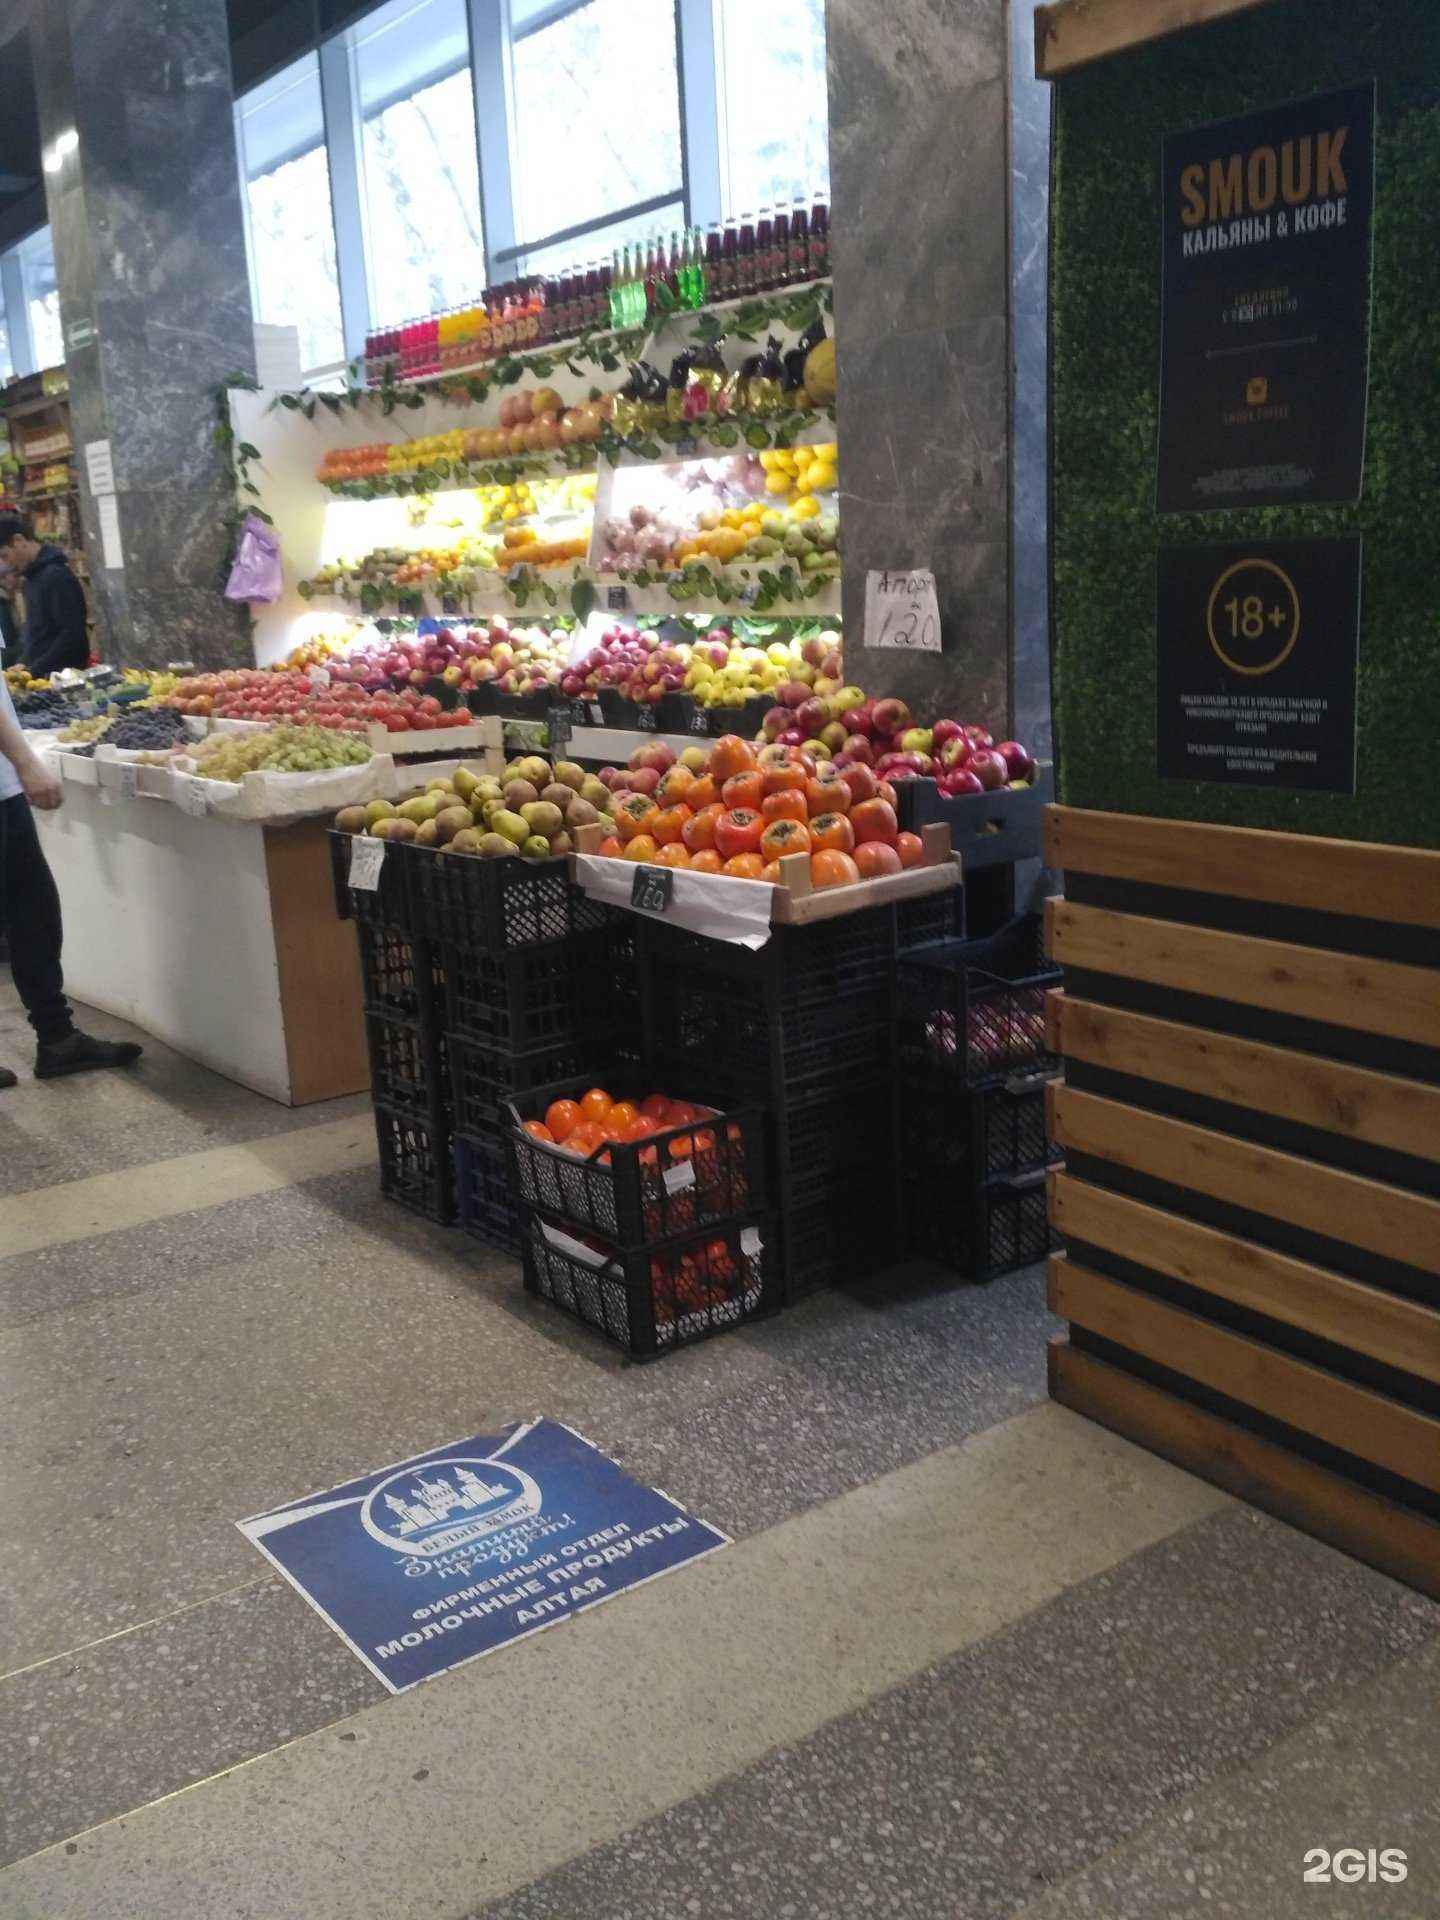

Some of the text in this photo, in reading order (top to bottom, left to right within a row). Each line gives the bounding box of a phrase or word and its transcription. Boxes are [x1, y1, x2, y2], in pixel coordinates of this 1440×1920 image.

[1180, 126, 1350, 226] SMOUK
[1182, 198, 1347, 258] КАЛЬЯНЫ & КОФЕ
[1225, 596, 1286, 638] 18+
[375, 1516, 691, 1660] МОЛОЧНЫЕ ПРОДУКТЫ
[412, 1522, 631, 1621] ФИРМЕННЫЙ ОТДЕЛ
[515, 1576, 608, 1626] АЛТАЯ
